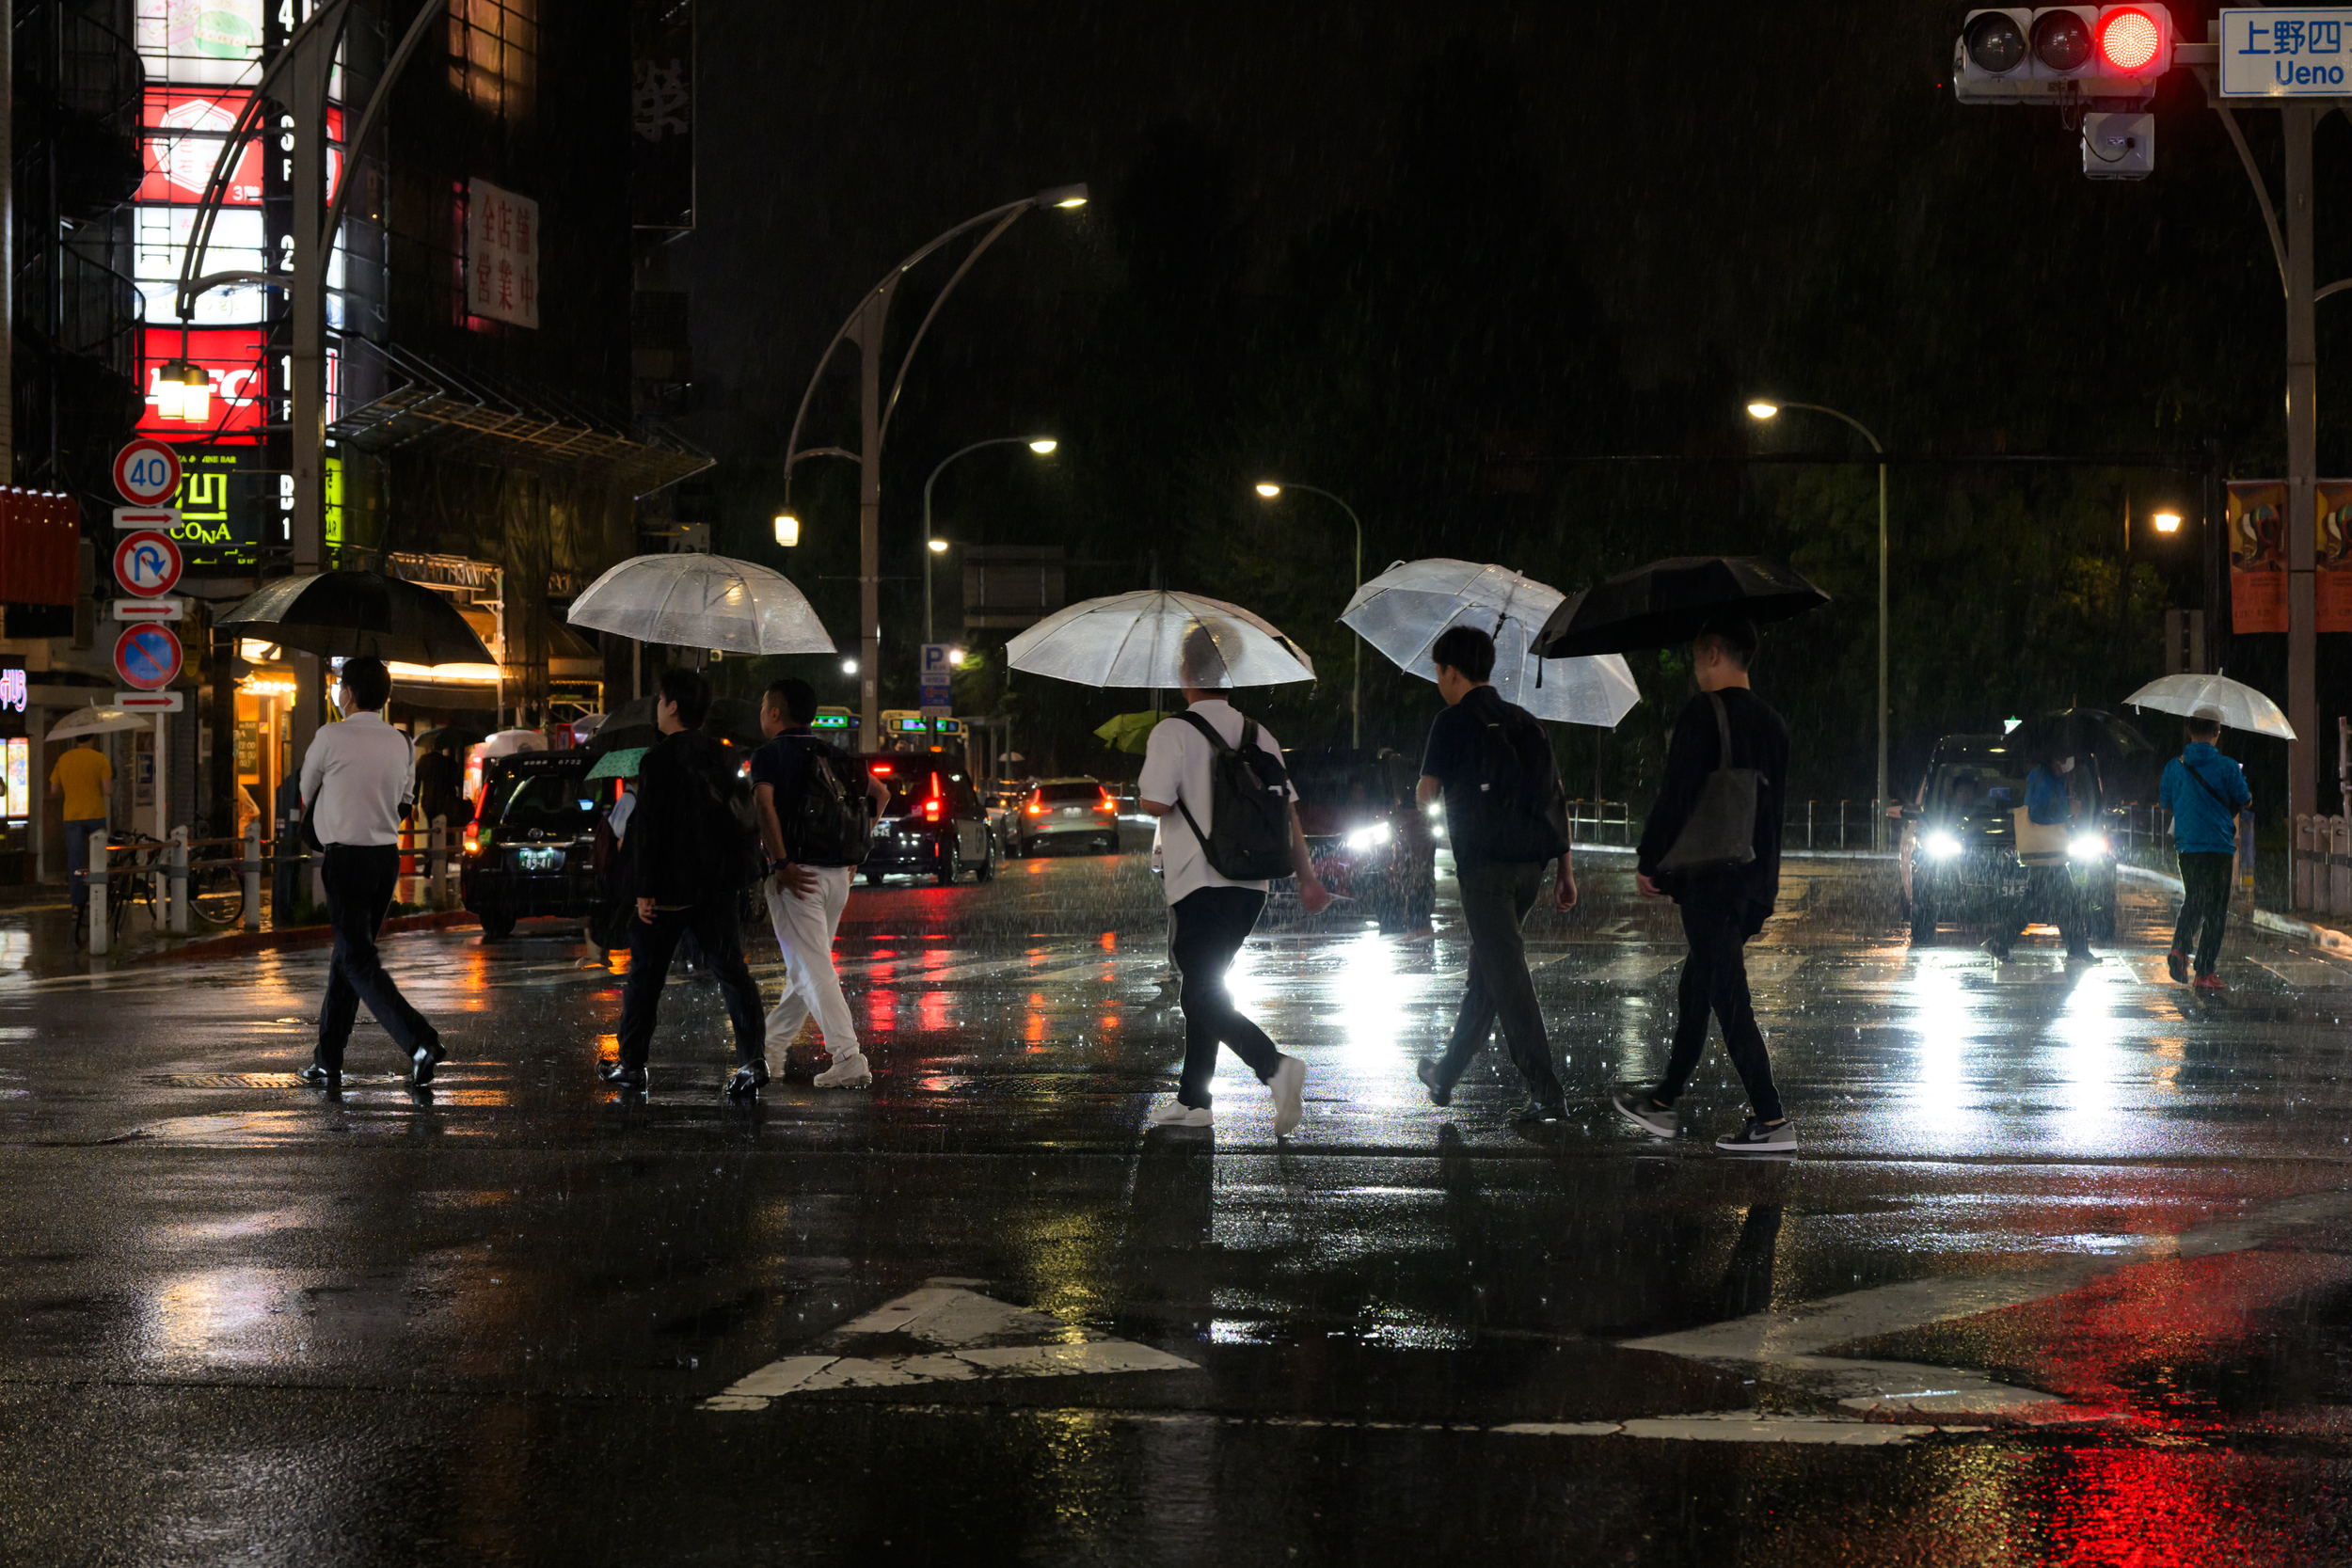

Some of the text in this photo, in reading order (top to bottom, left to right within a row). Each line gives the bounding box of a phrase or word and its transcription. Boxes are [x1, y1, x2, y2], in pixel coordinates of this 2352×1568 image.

[2238, 21, 2352, 55] 上野四
[2276, 61, 2344, 86] Ueno
[220, 455, 237, 464] BAR
[130, 458, 166, 487] 40
[169, 521, 232, 545] CONA
[926, 647, 944, 671] P
[0, 669, 27, 713] HUB
